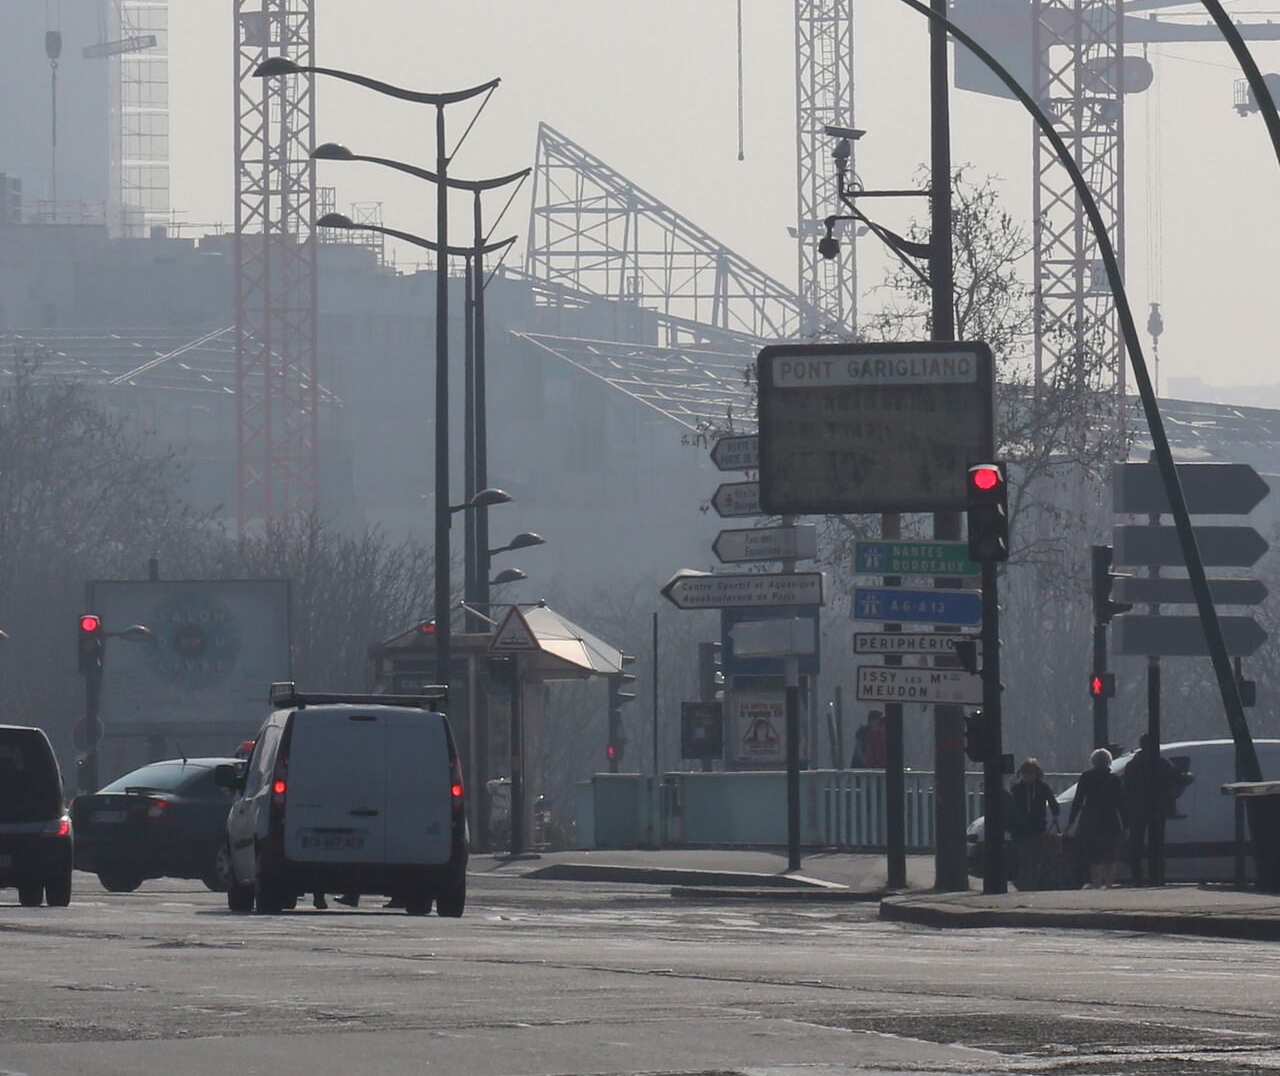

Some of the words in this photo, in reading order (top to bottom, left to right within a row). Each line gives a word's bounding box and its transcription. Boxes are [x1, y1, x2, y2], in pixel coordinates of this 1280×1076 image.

[780, 361, 833, 380] PONT
[847, 357, 970, 379] GARIGLIANO
[893, 546, 944, 557] NANTES
[893, 559, 965, 572] BORDEAUX
[682, 582, 712, 592] Centre
[717, 581, 750, 593] Sportif
[863, 671, 897, 682] ISSY
[905, 676, 923, 684] LES
[863, 684, 928, 697] MEUDON
